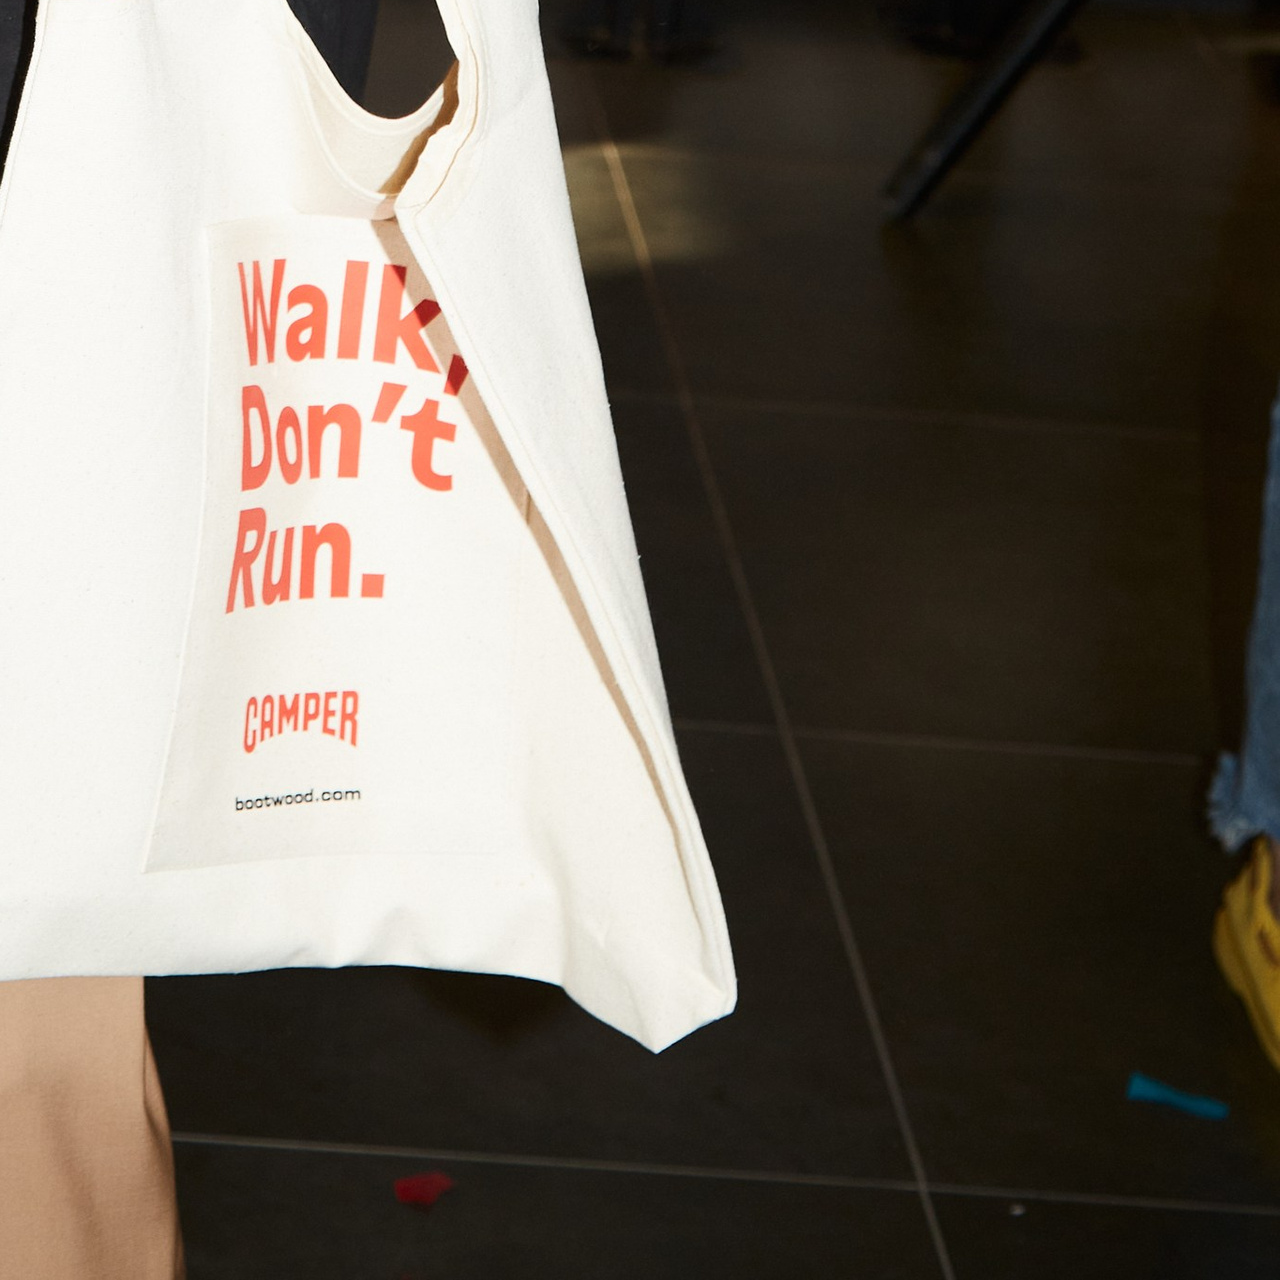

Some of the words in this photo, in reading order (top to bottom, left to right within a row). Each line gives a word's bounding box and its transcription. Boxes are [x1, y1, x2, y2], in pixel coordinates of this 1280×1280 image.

[237, 259, 469, 396] Walk,
[241, 382, 457, 492] Don't
[225, 507, 385, 614] Run.
[243, 690, 359, 754] CAMPER
[235, 789, 361, 811] bootwood.com
